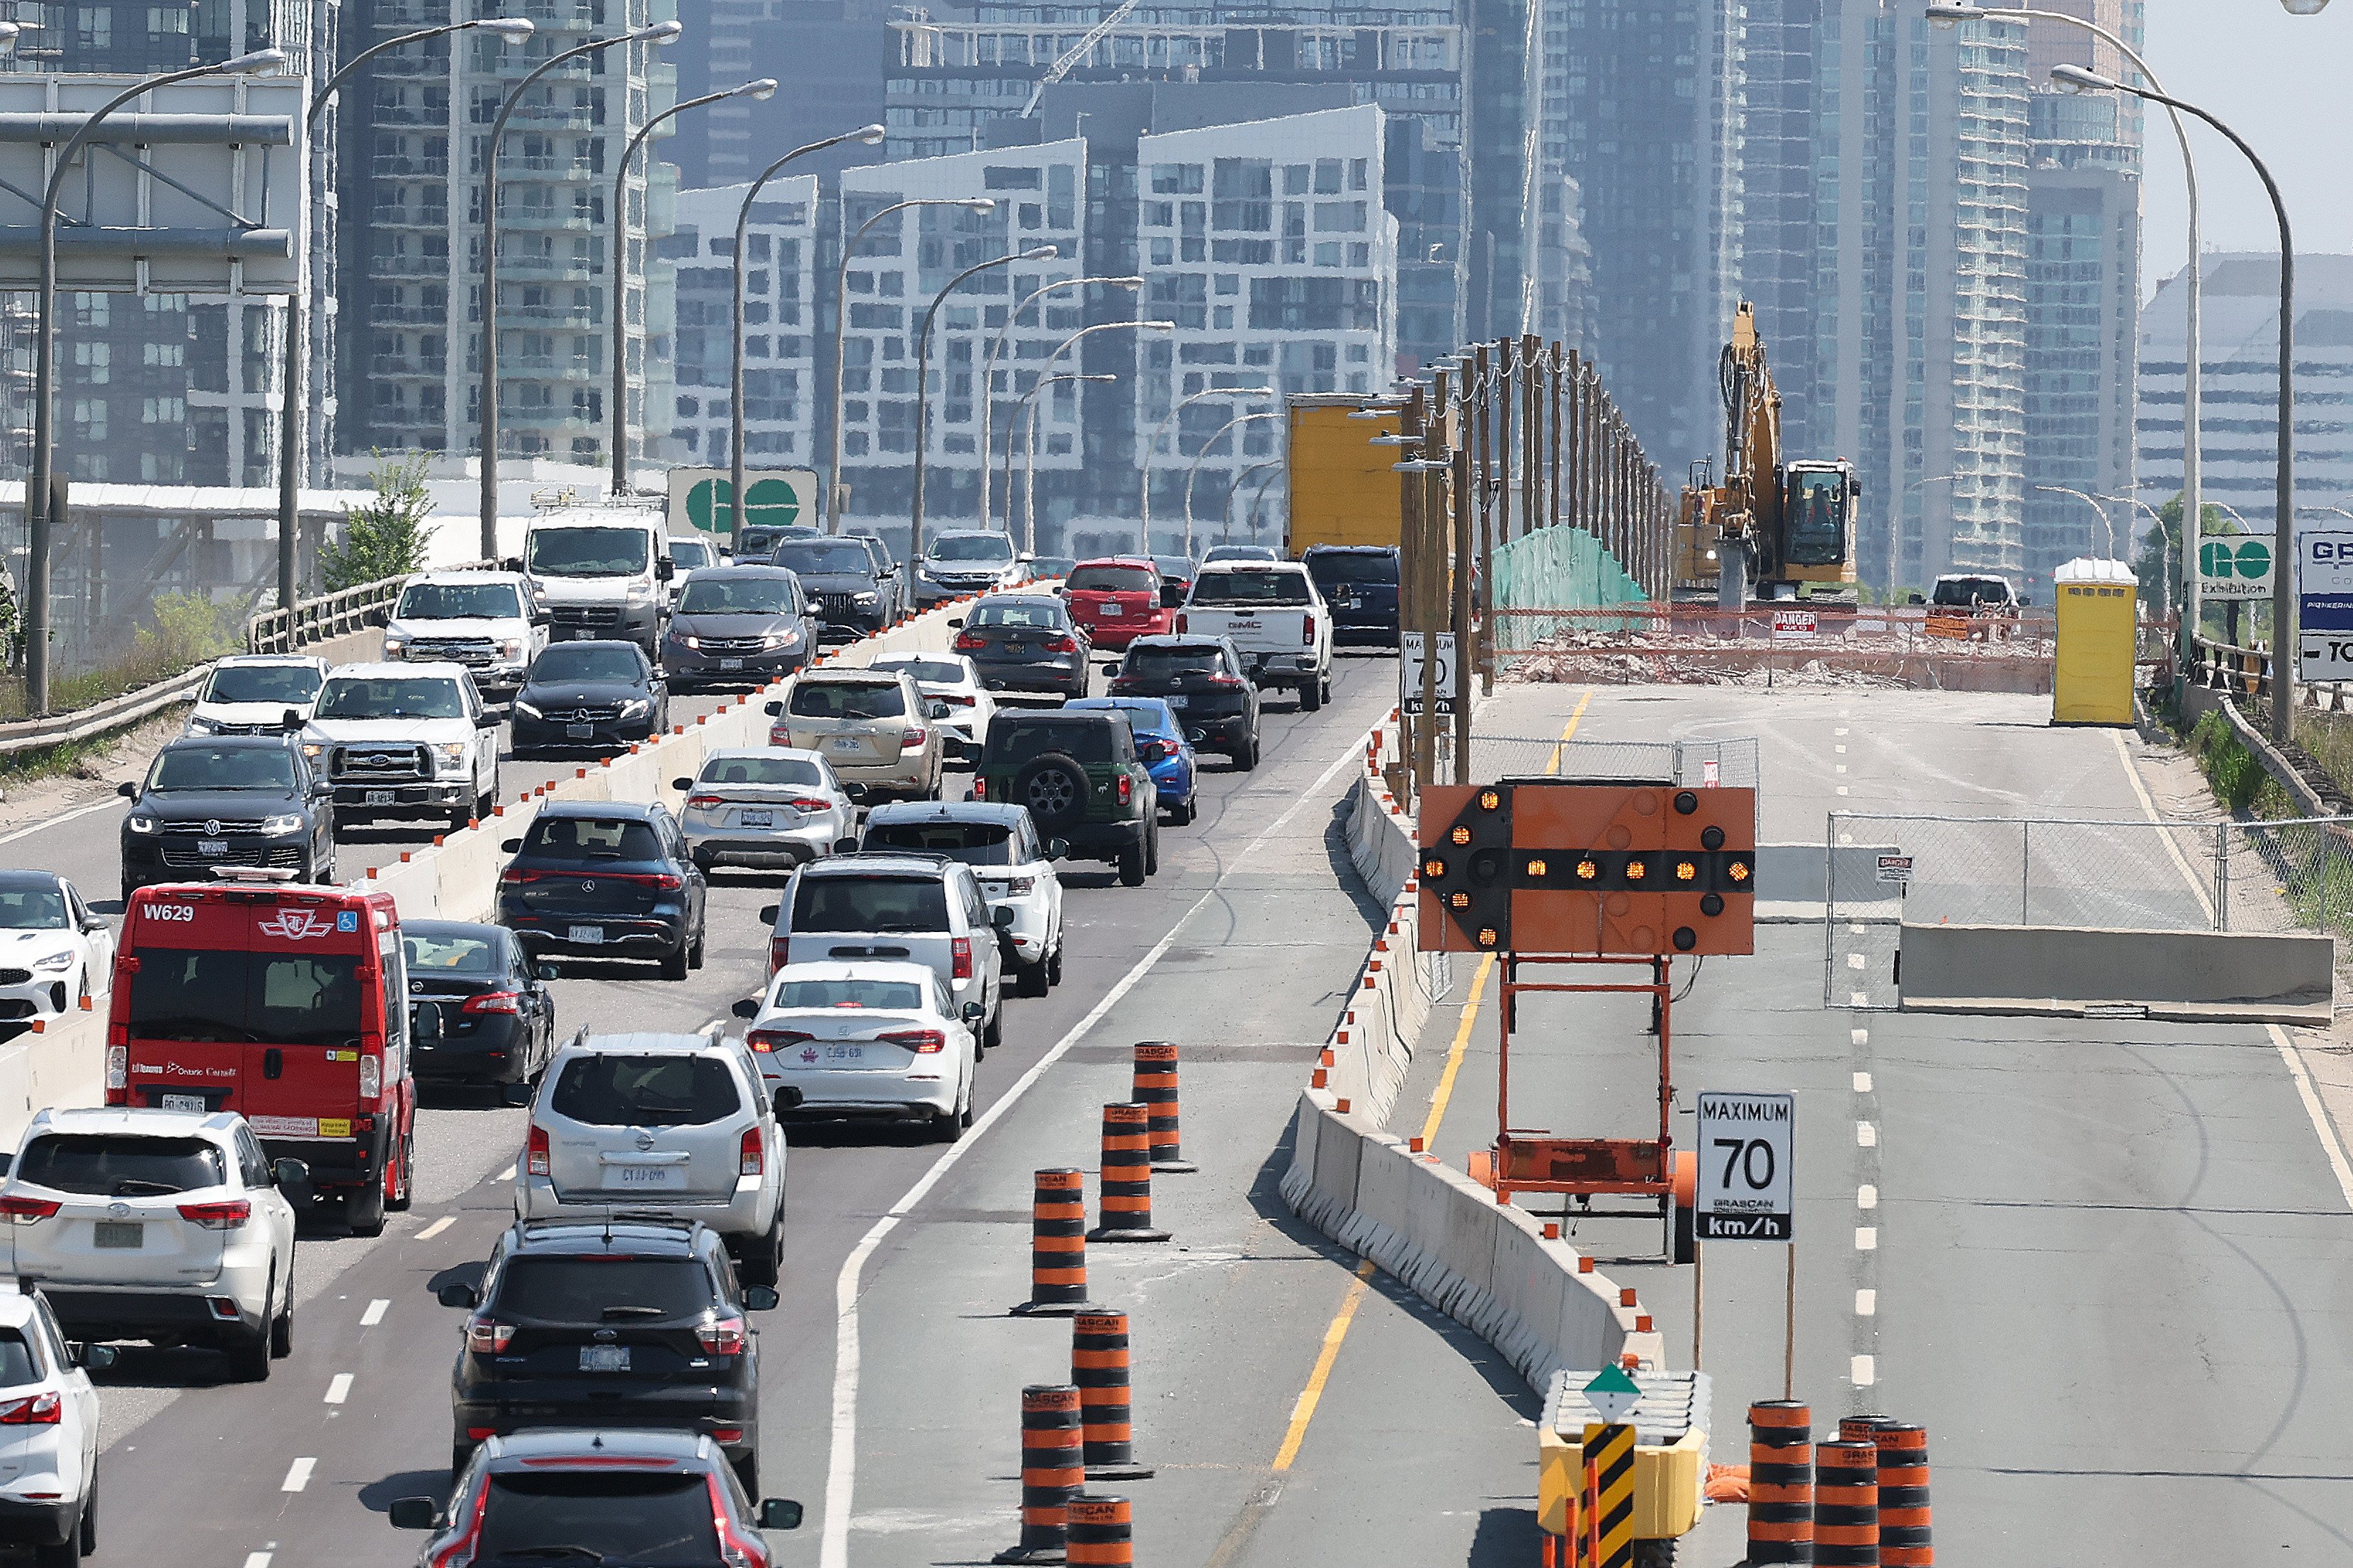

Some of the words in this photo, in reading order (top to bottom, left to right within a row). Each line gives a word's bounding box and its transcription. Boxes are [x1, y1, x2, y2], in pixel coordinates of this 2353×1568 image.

[2201, 582, 2267, 594] Exhibition
[1775, 613, 1815, 625] DANGER
[144, 904, 193, 921] W629
[178, 1067, 203, 1076] Ontario
[1703, 1101, 1788, 1122] MAXIMUM
[1713, 1138, 1775, 1190] 70
[1713, 1198, 1774, 1208] GRASCAN
[1708, 1215, 1780, 1236] km/h
